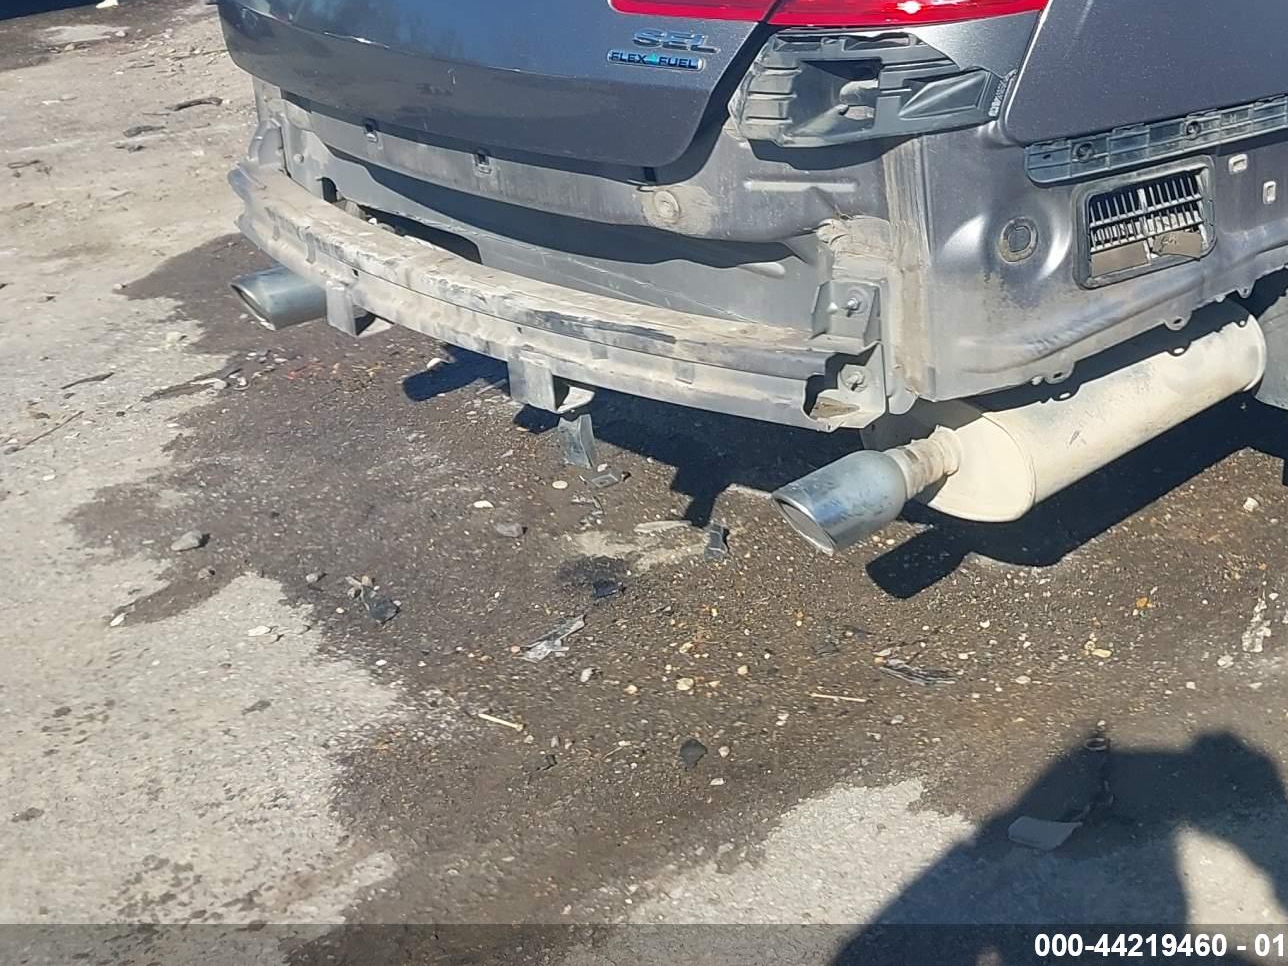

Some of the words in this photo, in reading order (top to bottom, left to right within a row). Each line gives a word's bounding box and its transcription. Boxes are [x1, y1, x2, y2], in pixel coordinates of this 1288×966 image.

[632, 27, 721, 54] SEL
[609, 51, 647, 64] FLEX
[658, 56, 698, 69] FUEL
